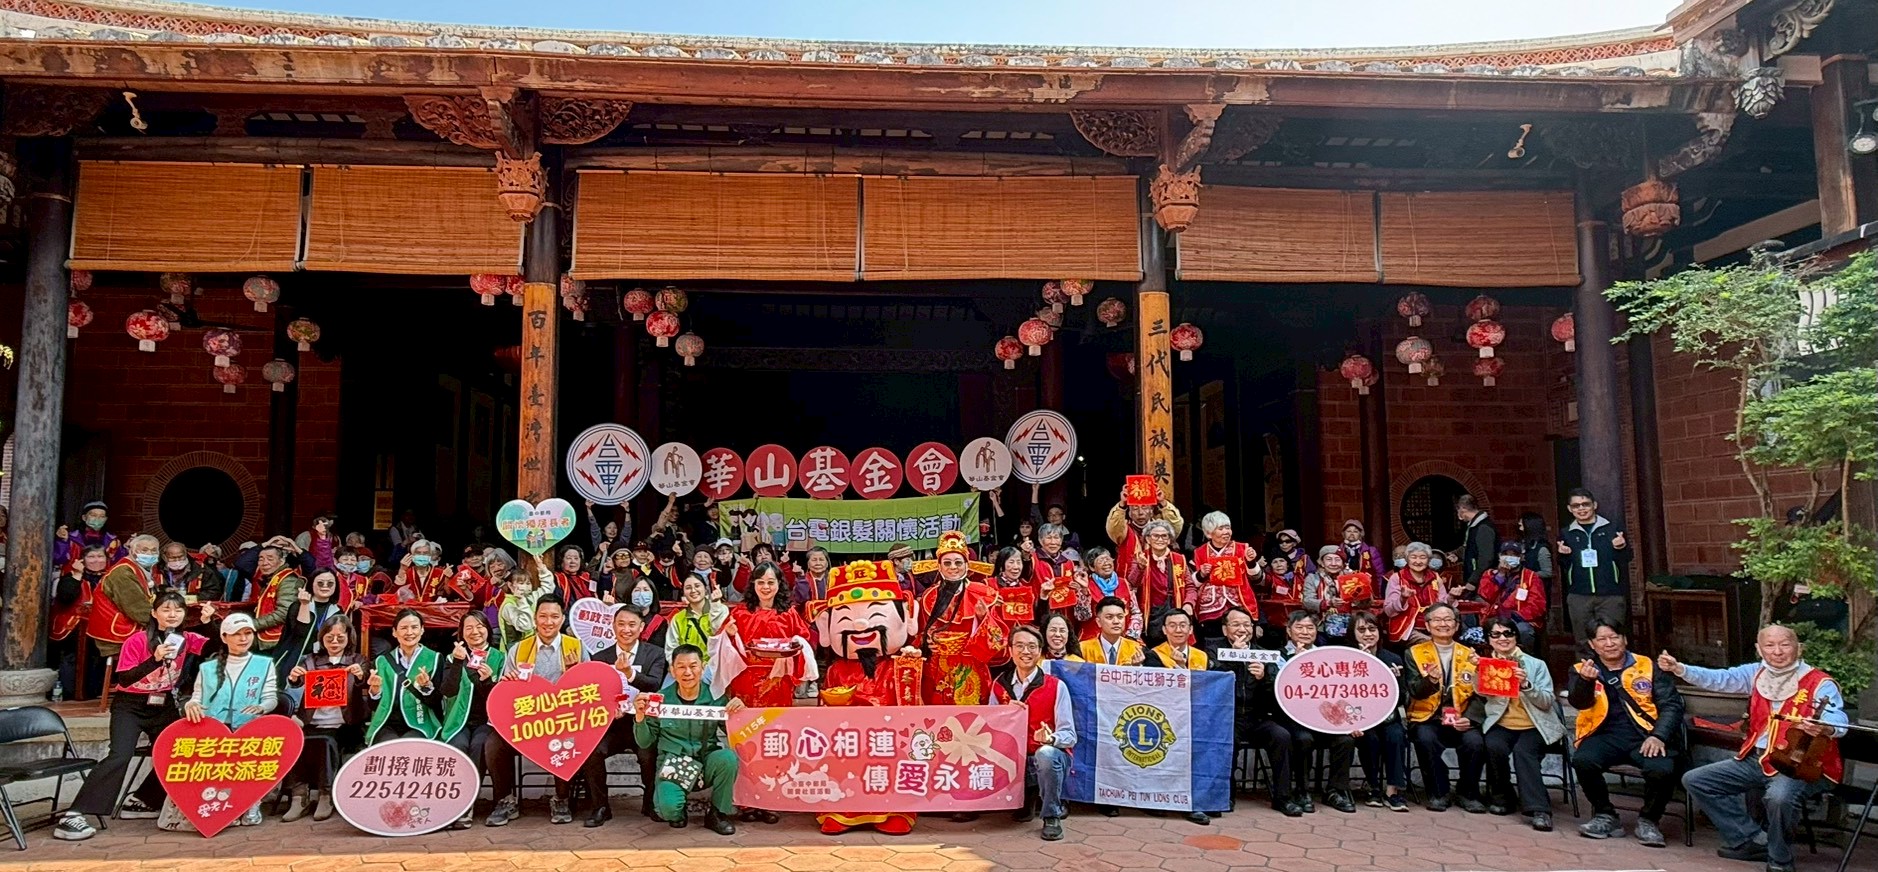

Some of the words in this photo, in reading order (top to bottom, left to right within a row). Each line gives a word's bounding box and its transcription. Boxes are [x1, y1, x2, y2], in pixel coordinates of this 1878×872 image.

[703, 447, 954, 495] 華山基金會
[785, 513, 962, 543] 台電銀髮關懷活動
[1100, 669, 1188, 689] 台中市北屯獅子會
[1299, 660, 1370, 679] 愛心專線
[513, 683, 602, 719] 愛心年菜
[1284, 683, 1389, 700] 04-24734843
[510, 706, 610, 743] 1000元/份
[1125, 706, 1162, 721] LIONS
[739, 715, 768, 739] 115年
[1137, 723, 1154, 746] L
[170, 736, 285, 758] 獨老年夜飯
[763, 728, 896, 760] 郵心相連
[165, 760, 279, 782] 由你來添愛
[363, 755, 457, 777] 劃撥帳號
[864, 762, 995, 795] 傳愛永續
[349, 780, 462, 800] 22542465
